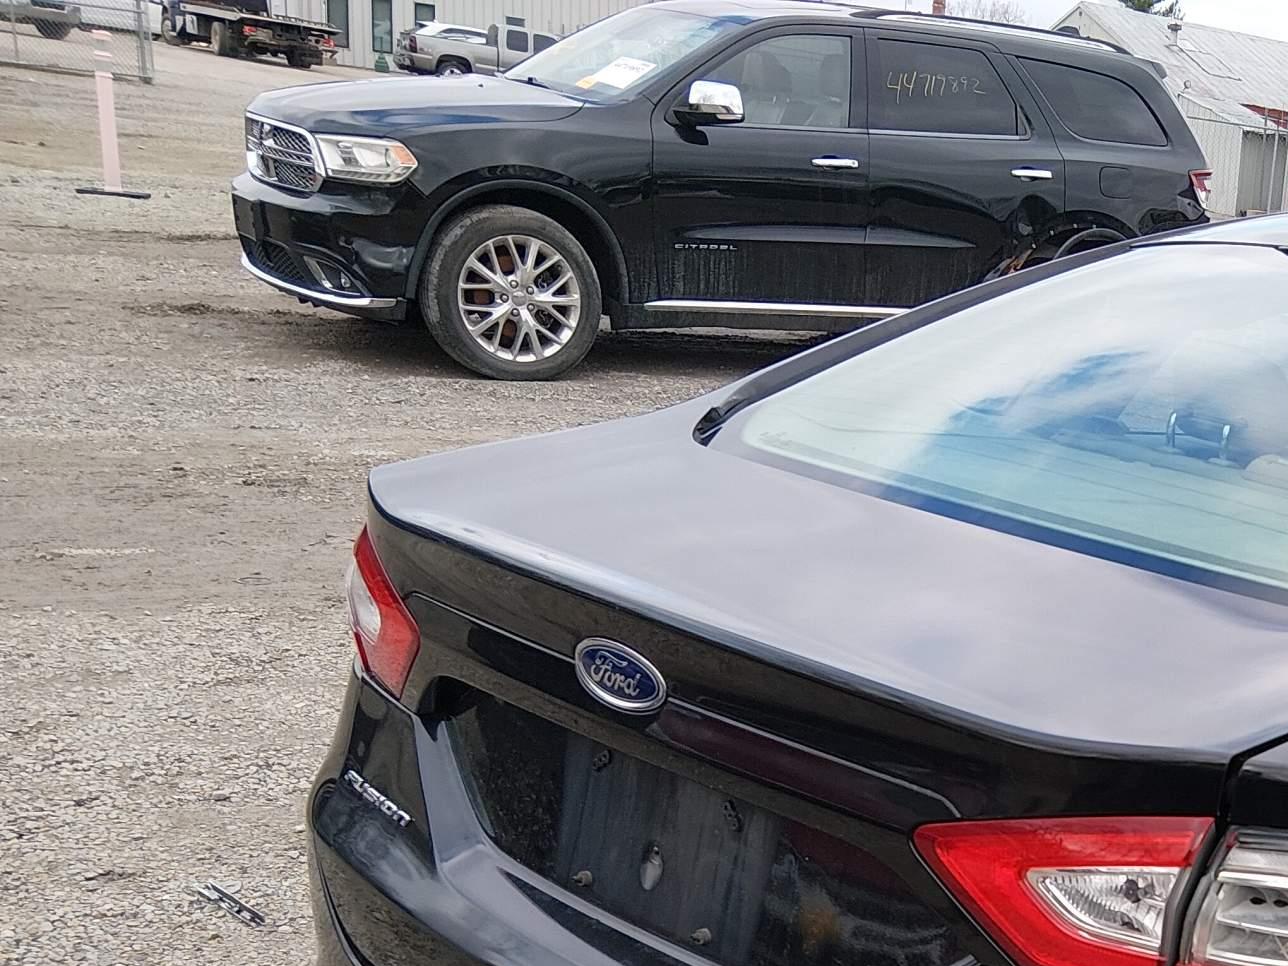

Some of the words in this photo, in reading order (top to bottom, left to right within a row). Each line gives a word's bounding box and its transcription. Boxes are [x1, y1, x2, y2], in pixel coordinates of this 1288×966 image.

[886, 71, 986, 104] 44719892
[590, 651, 642, 697] Ford
[343, 769, 413, 828] FUSION
